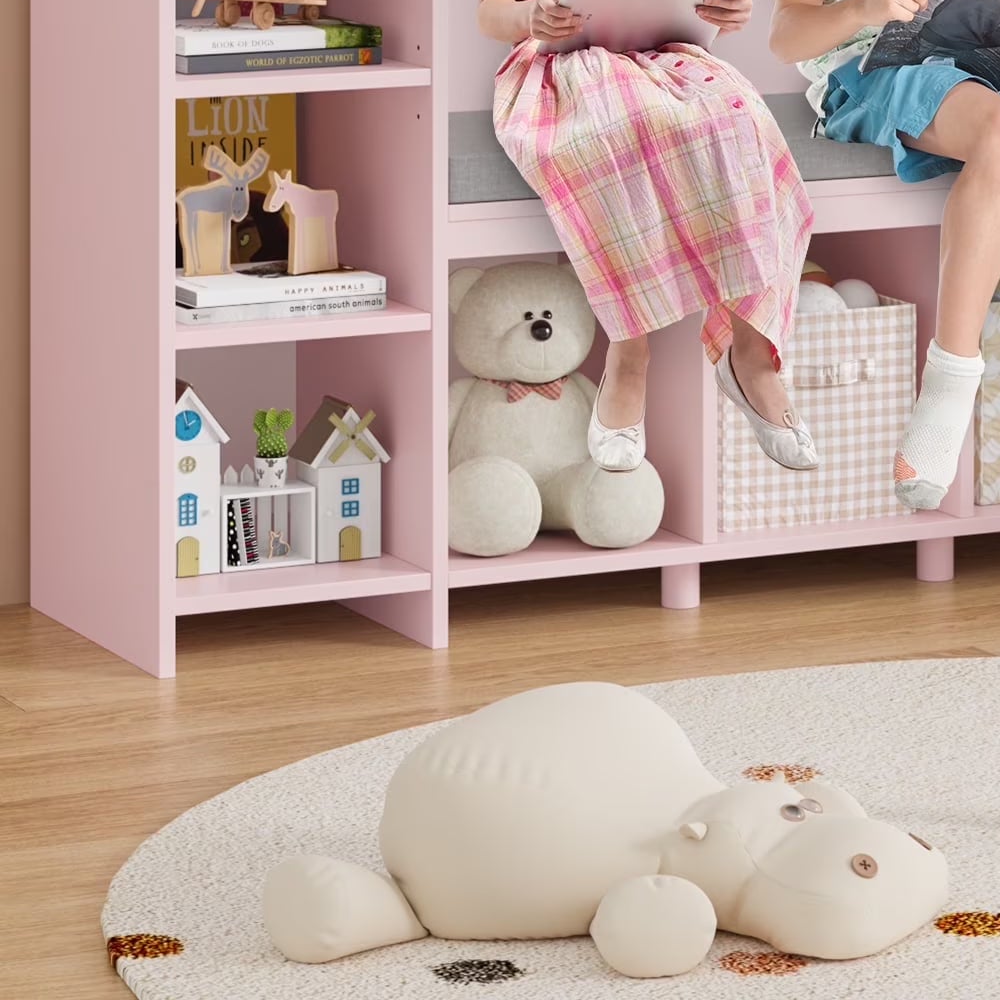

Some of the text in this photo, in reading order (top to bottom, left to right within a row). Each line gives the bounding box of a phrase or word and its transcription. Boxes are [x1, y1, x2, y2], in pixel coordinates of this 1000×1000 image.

[211, 39, 275, 49] BOOK OF DOGS
[245, 53, 354, 67] WORLD OF EGZOTIC PARROT
[185, 96, 269, 137] LION
[284, 283, 365, 296] HAPPY ANIMALS
[289, 298, 383, 313] american south animals
